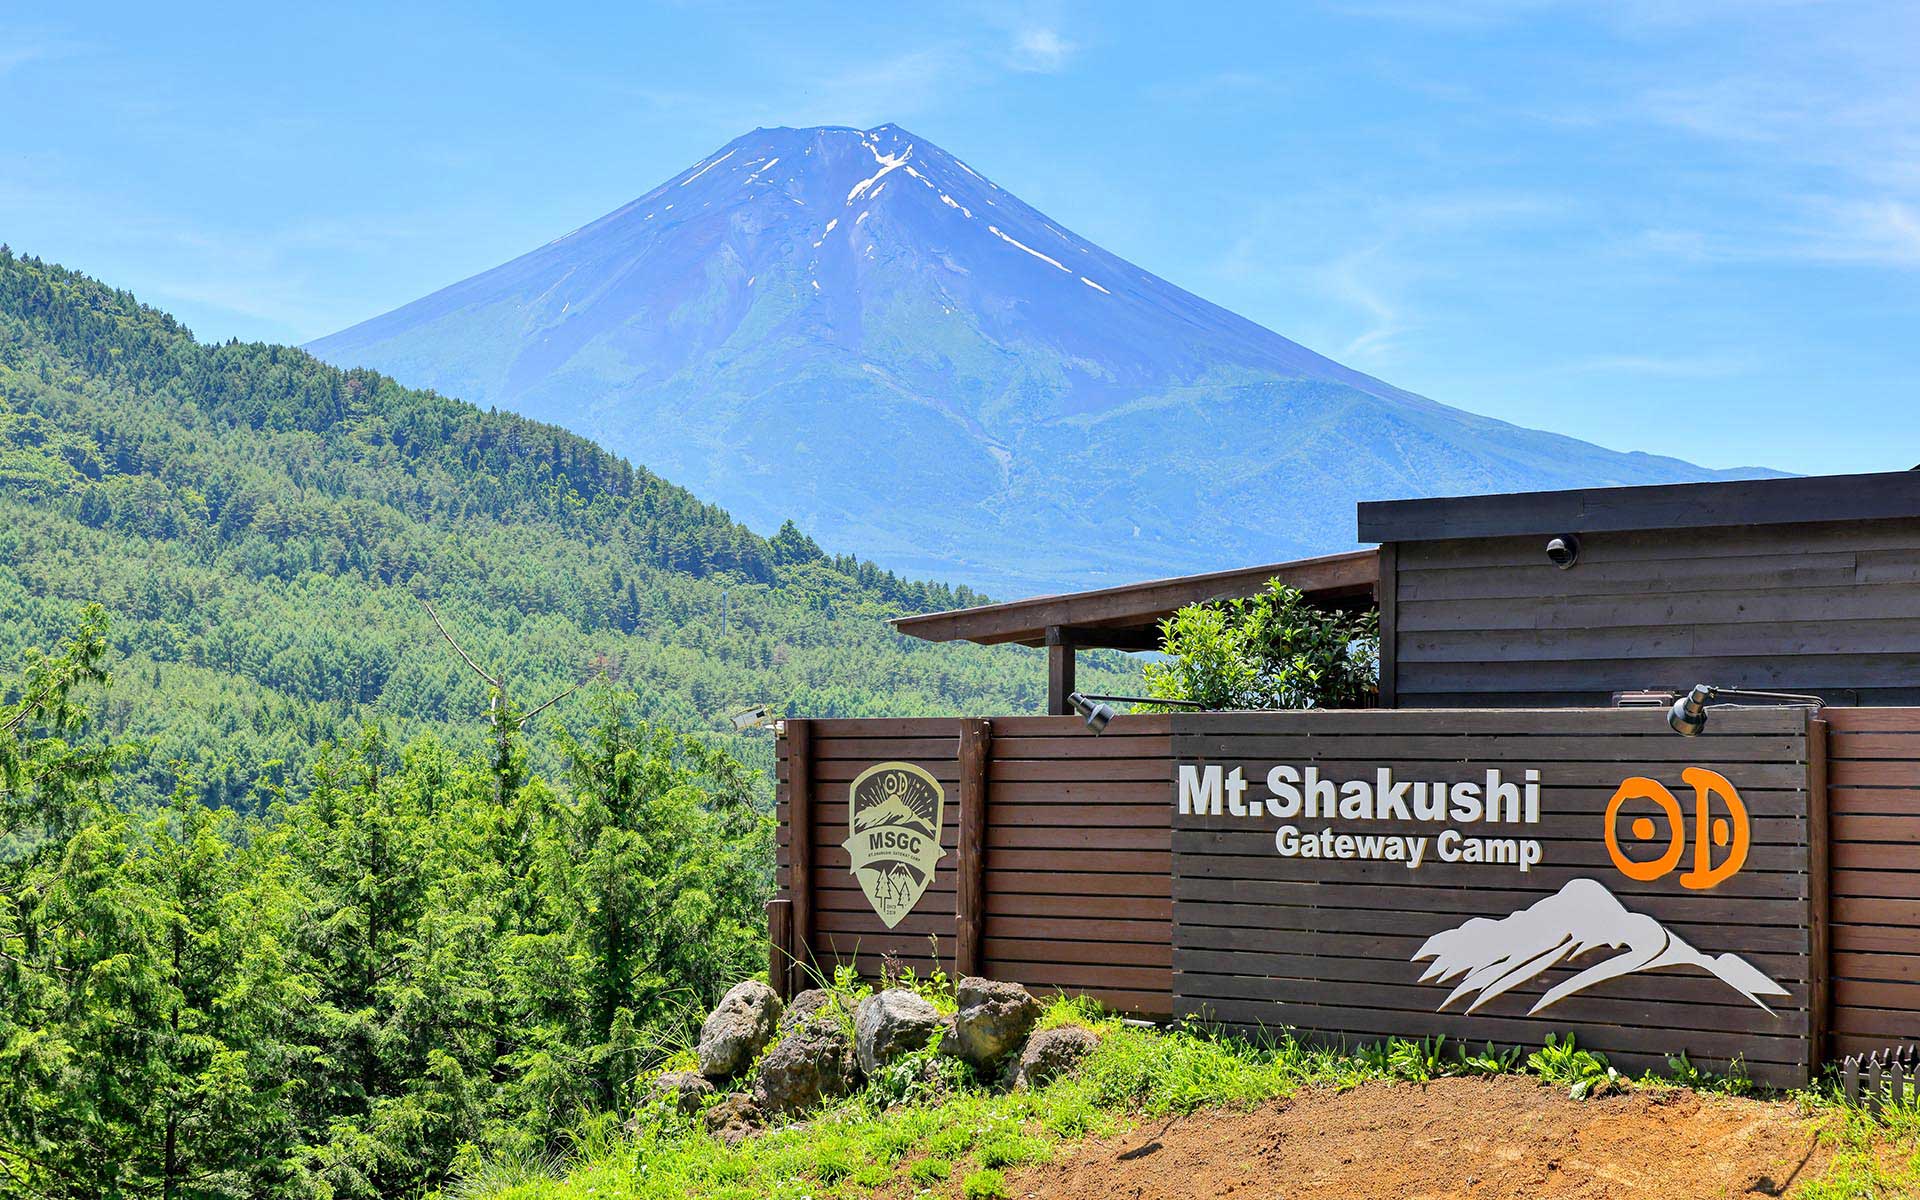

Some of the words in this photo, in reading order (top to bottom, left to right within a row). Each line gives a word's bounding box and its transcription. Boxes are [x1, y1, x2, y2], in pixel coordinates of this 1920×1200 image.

[1178, 765, 1541, 823] Mt.Shakushi
[869, 831, 921, 854] MSGC
[1275, 825, 1428, 869] Gateway
[1437, 829, 1543, 872] Camp
